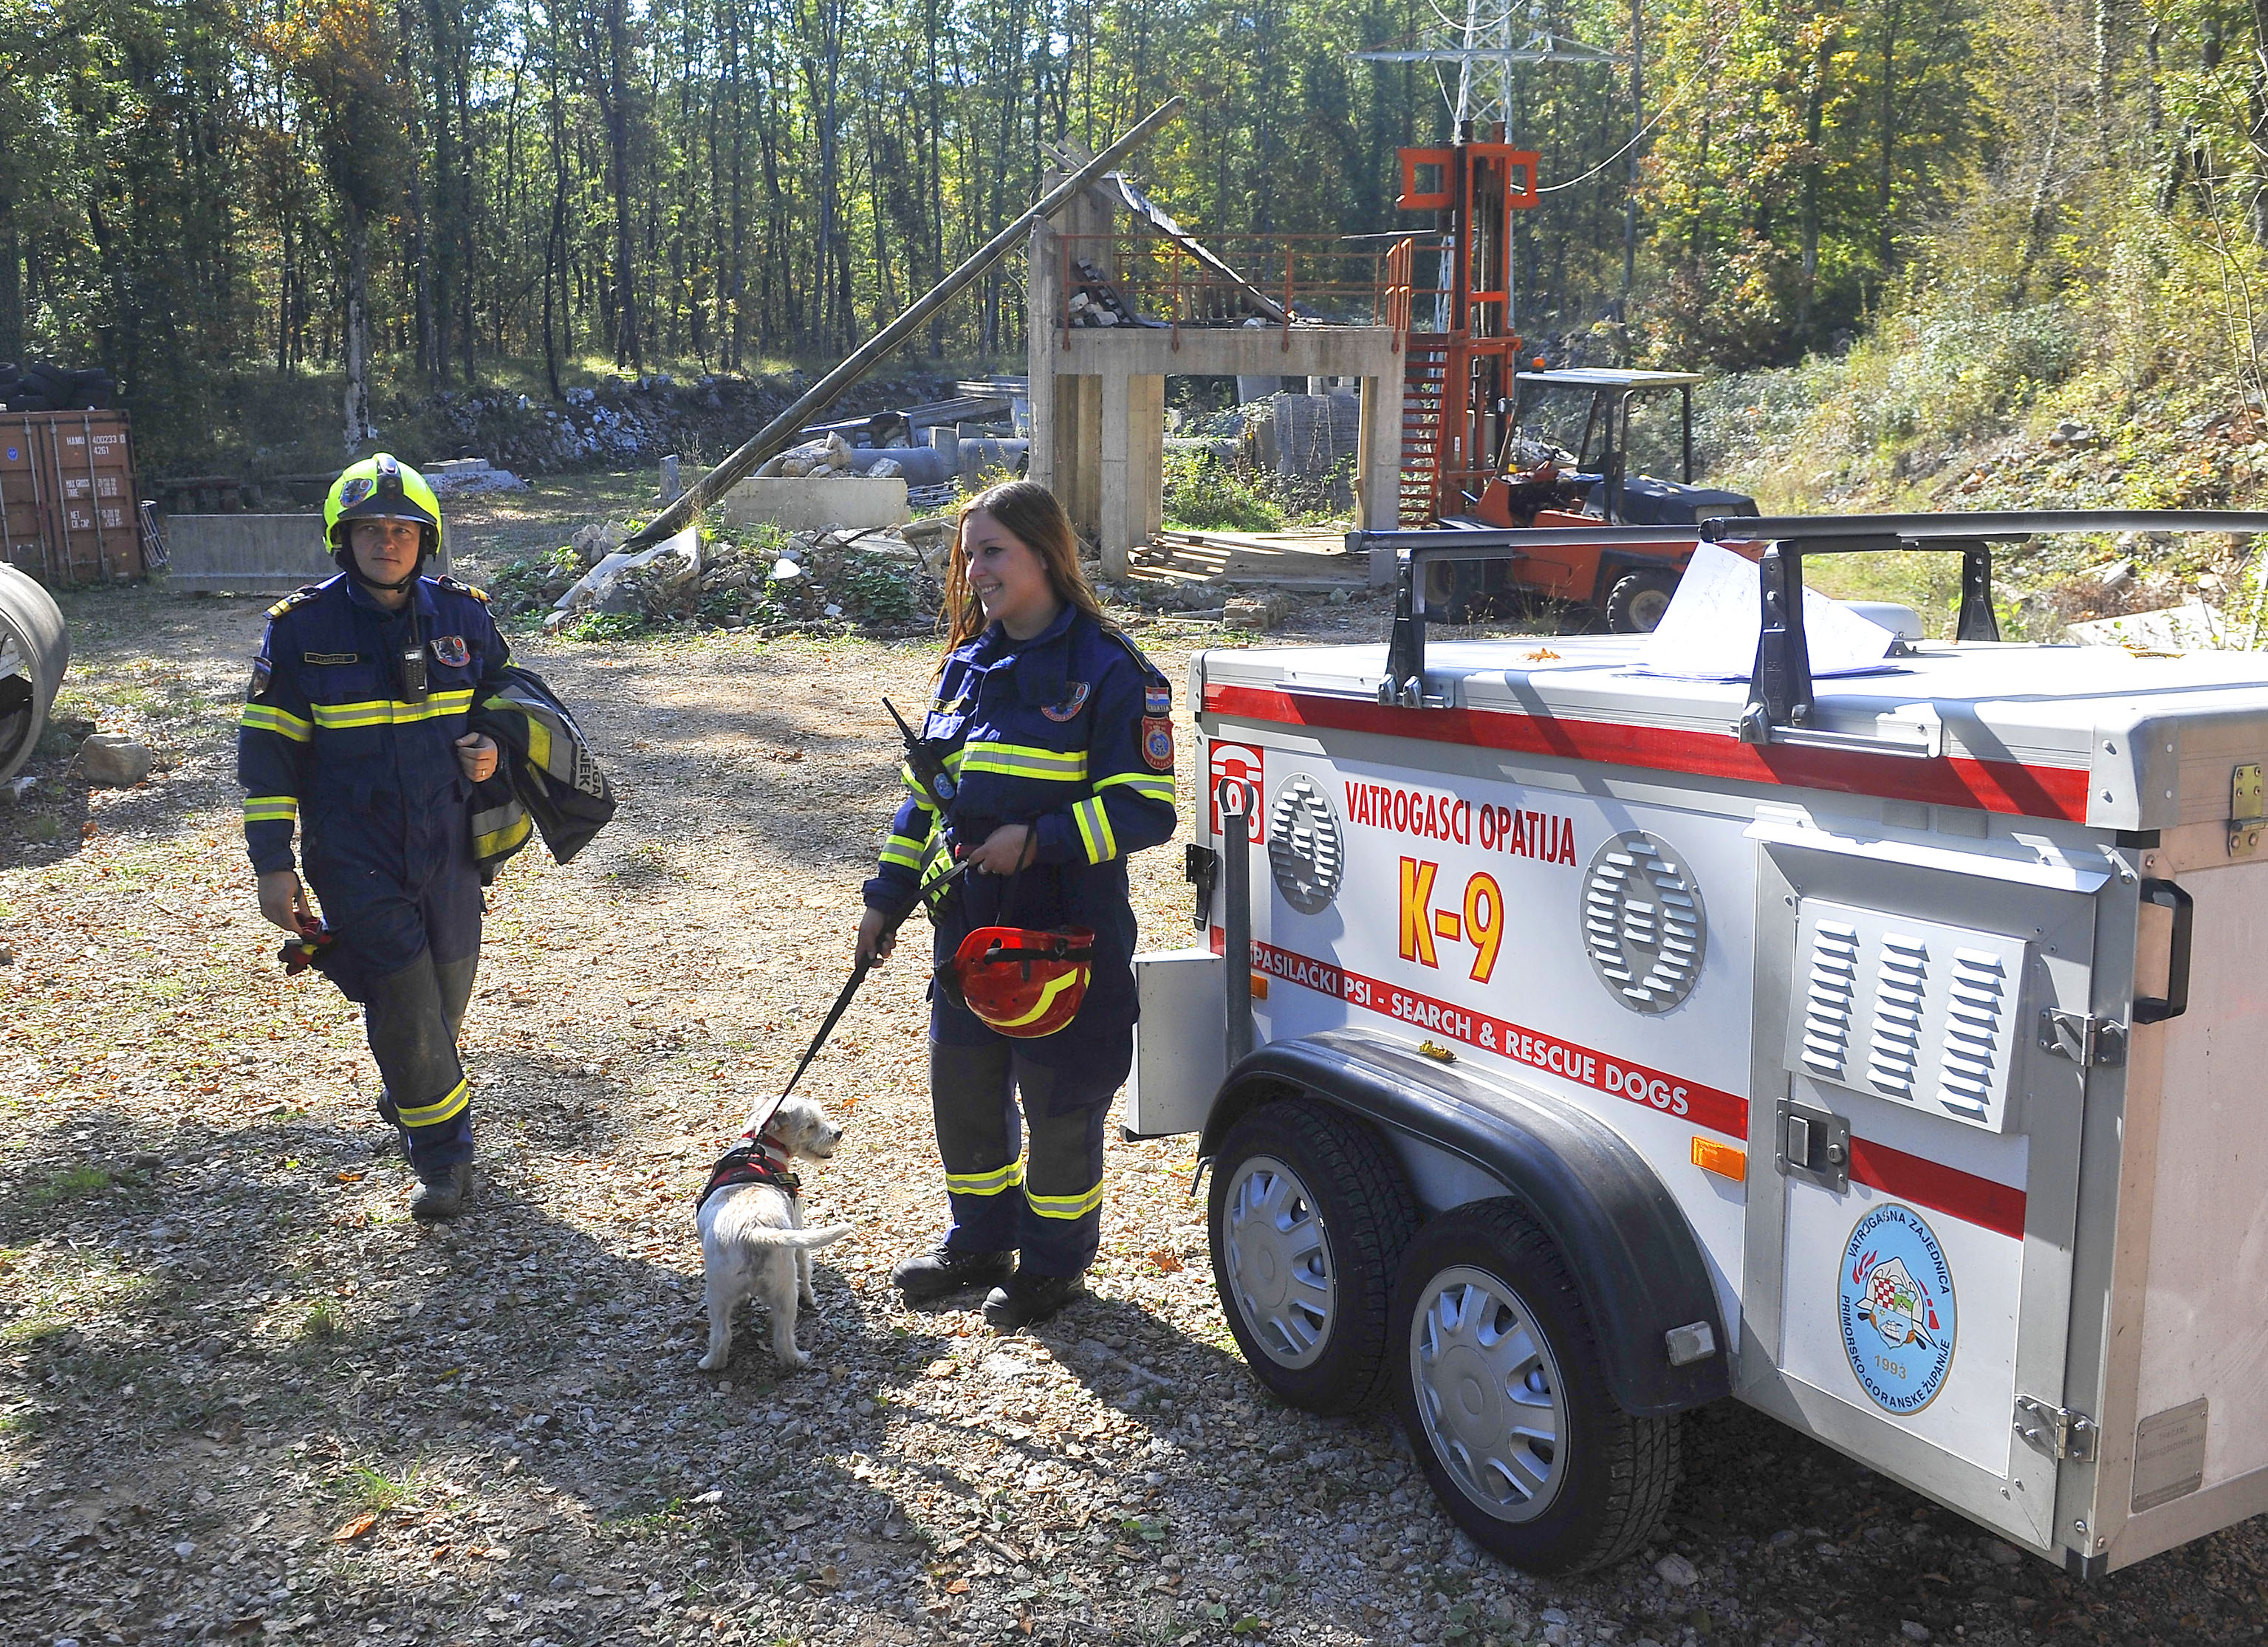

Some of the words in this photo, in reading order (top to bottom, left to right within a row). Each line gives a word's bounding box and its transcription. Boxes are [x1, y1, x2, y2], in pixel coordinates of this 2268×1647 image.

[92, 435, 117, 444] 400233
[94, 446, 109, 454] 4261
[1345, 781, 1470, 845] VATROGASCI
[1479, 804, 1577, 866] OPATIJA
[1399, 855, 1504, 985] K-9
[1343, 976, 1371, 1005] PSI
[1391, 993, 1472, 1040] SEARCH
[1479, 1022, 1498, 1050] &
[1505, 1030, 1596, 1084] RESCUE
[1605, 1064, 1689, 1115] DOGS
[1849, 1211, 1906, 1257] VATROGASNA
[1908, 1219, 1950, 1295] ZAJEDNICA
[1841, 1295, 1926, 1408] PRIMORSKO-GORANSKE
[1921, 1339, 1950, 1396] ŽUPANIJE
[1874, 1355, 1907, 1380] 1993
